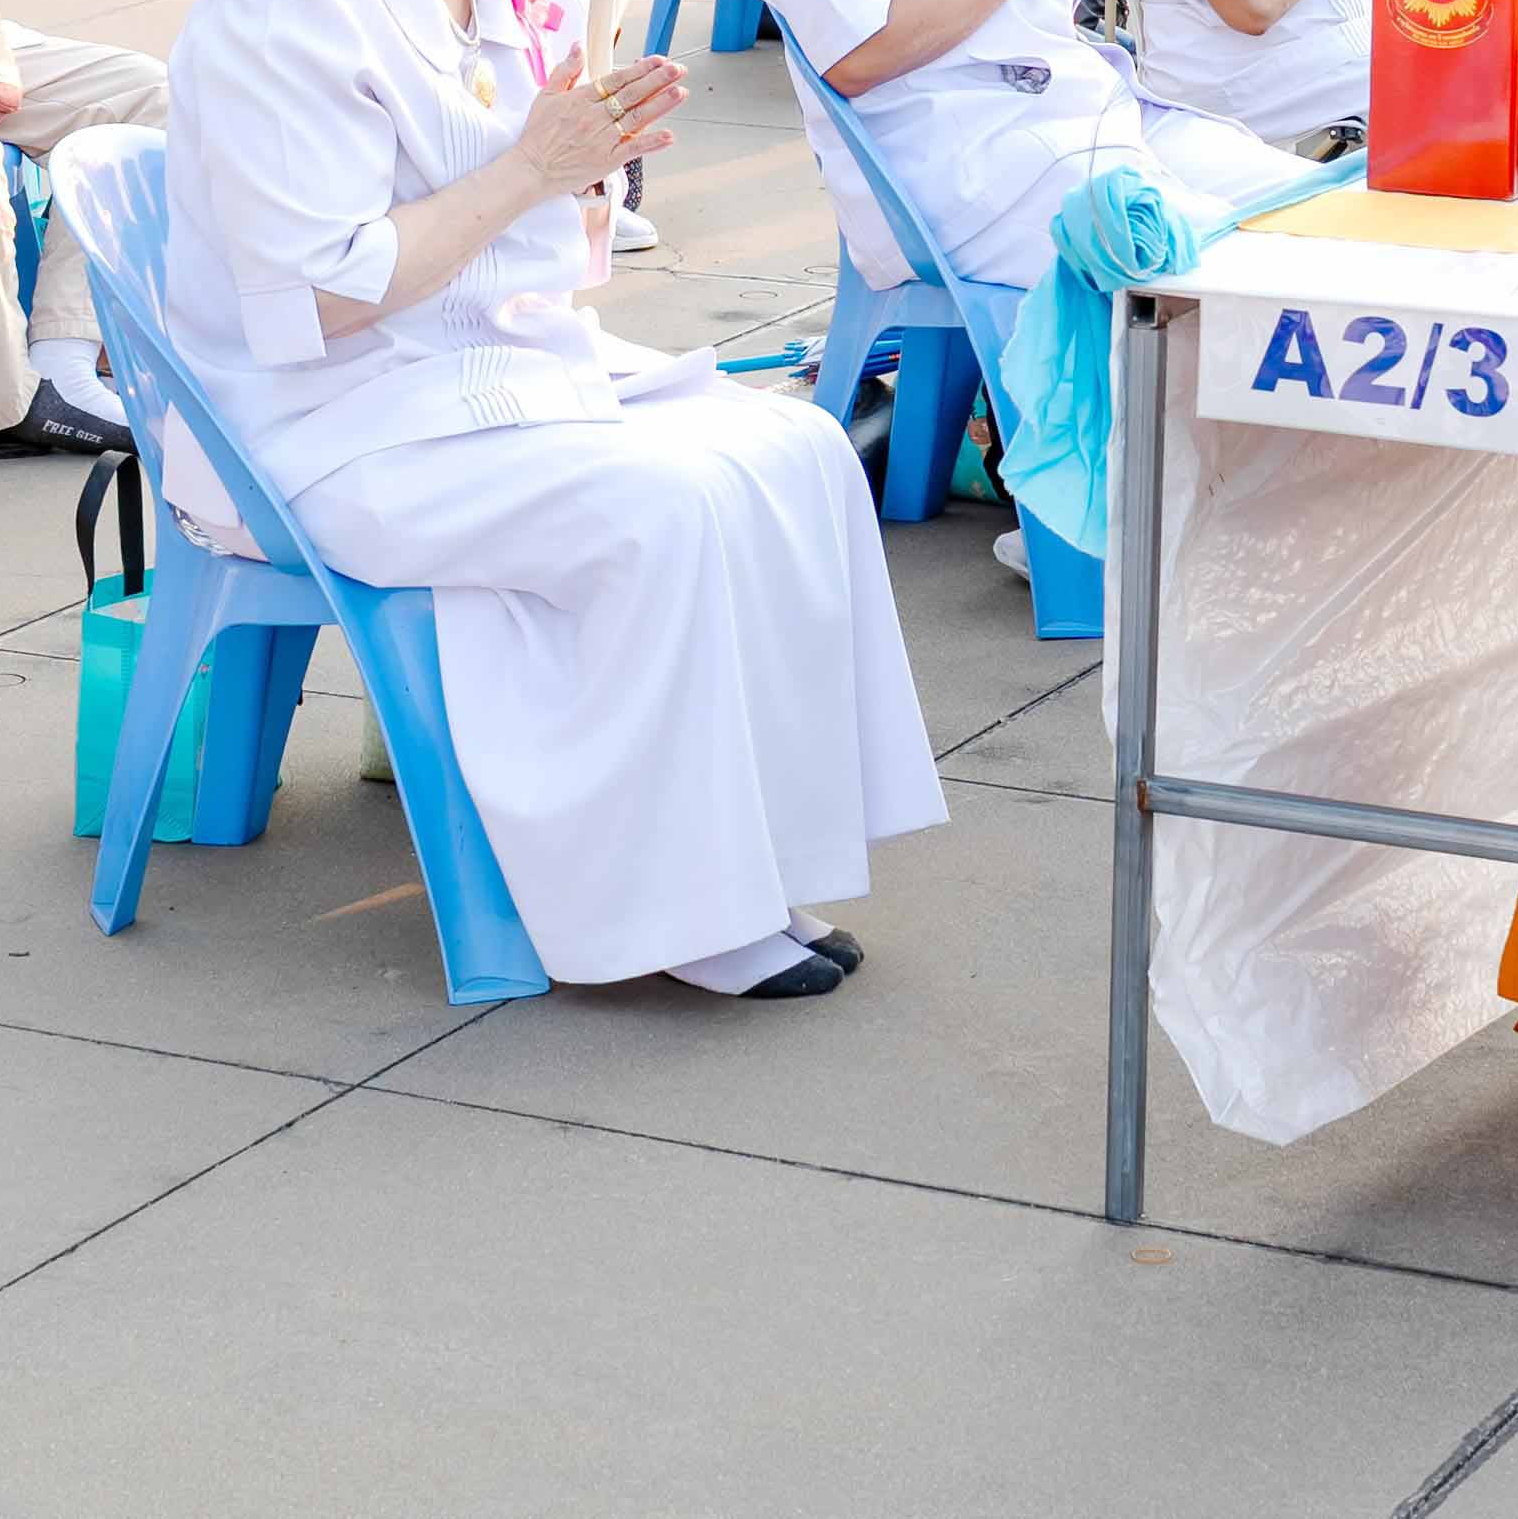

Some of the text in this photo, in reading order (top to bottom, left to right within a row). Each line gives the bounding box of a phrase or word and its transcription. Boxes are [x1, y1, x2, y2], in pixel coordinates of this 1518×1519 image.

[1251, 308, 1510, 418] A2/3
[41, 418, 104, 444] FREE SIZE
